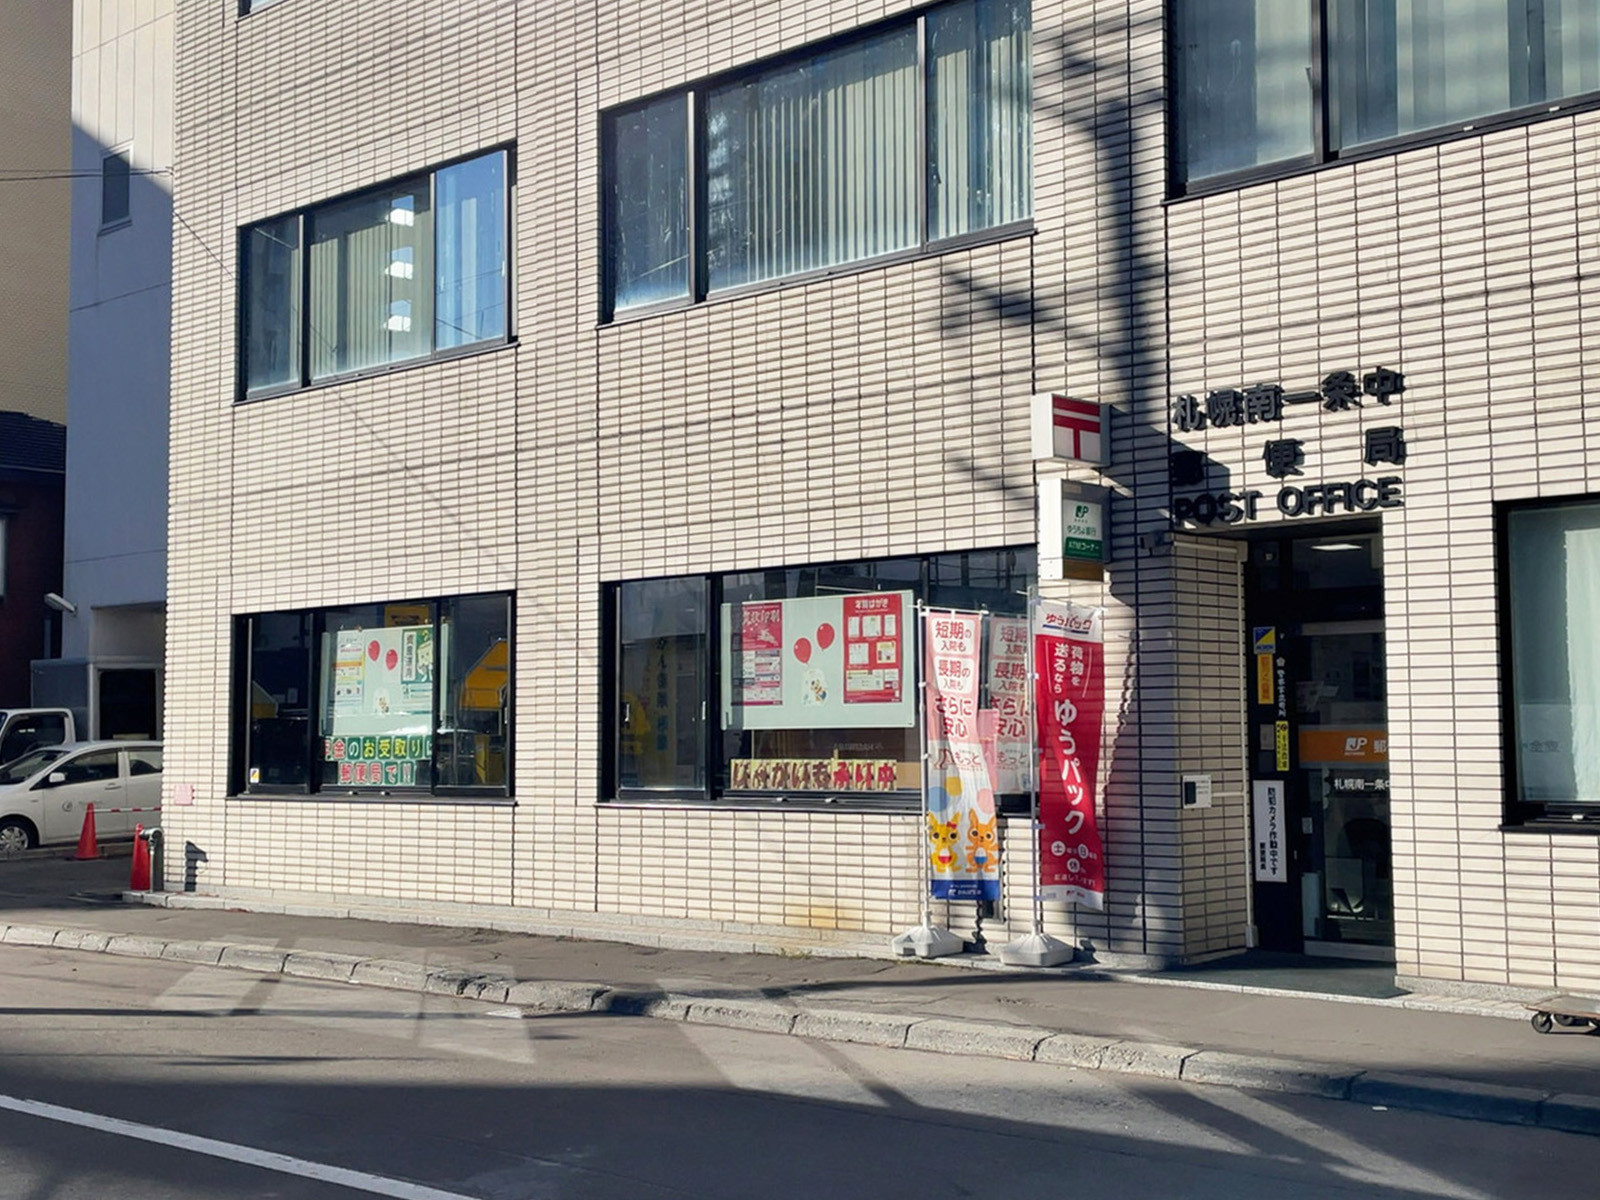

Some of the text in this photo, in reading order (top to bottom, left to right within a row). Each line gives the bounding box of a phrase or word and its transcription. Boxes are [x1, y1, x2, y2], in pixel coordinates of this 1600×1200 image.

[1172, 366, 1405, 432] 札幌南一条中
[1171, 426, 1406, 487] 便局
[1174, 475, 1404, 525] POST OFFICE
[935, 620, 972, 639] 短期の
[1046, 613, 1092, 630] ゆうパック
[941, 640, 966, 652] 入院も
[1070, 645, 1084, 686] 荷物を
[938, 659, 971, 678] 長期の
[1054, 642, 1069, 694] 送るなら
[935, 694, 972, 716] さらに
[943, 716, 967, 737] 安心
[1054, 699, 1085, 834] ゆうパック
[1267, 786, 1279, 876] 防犯カメラ作動中です
